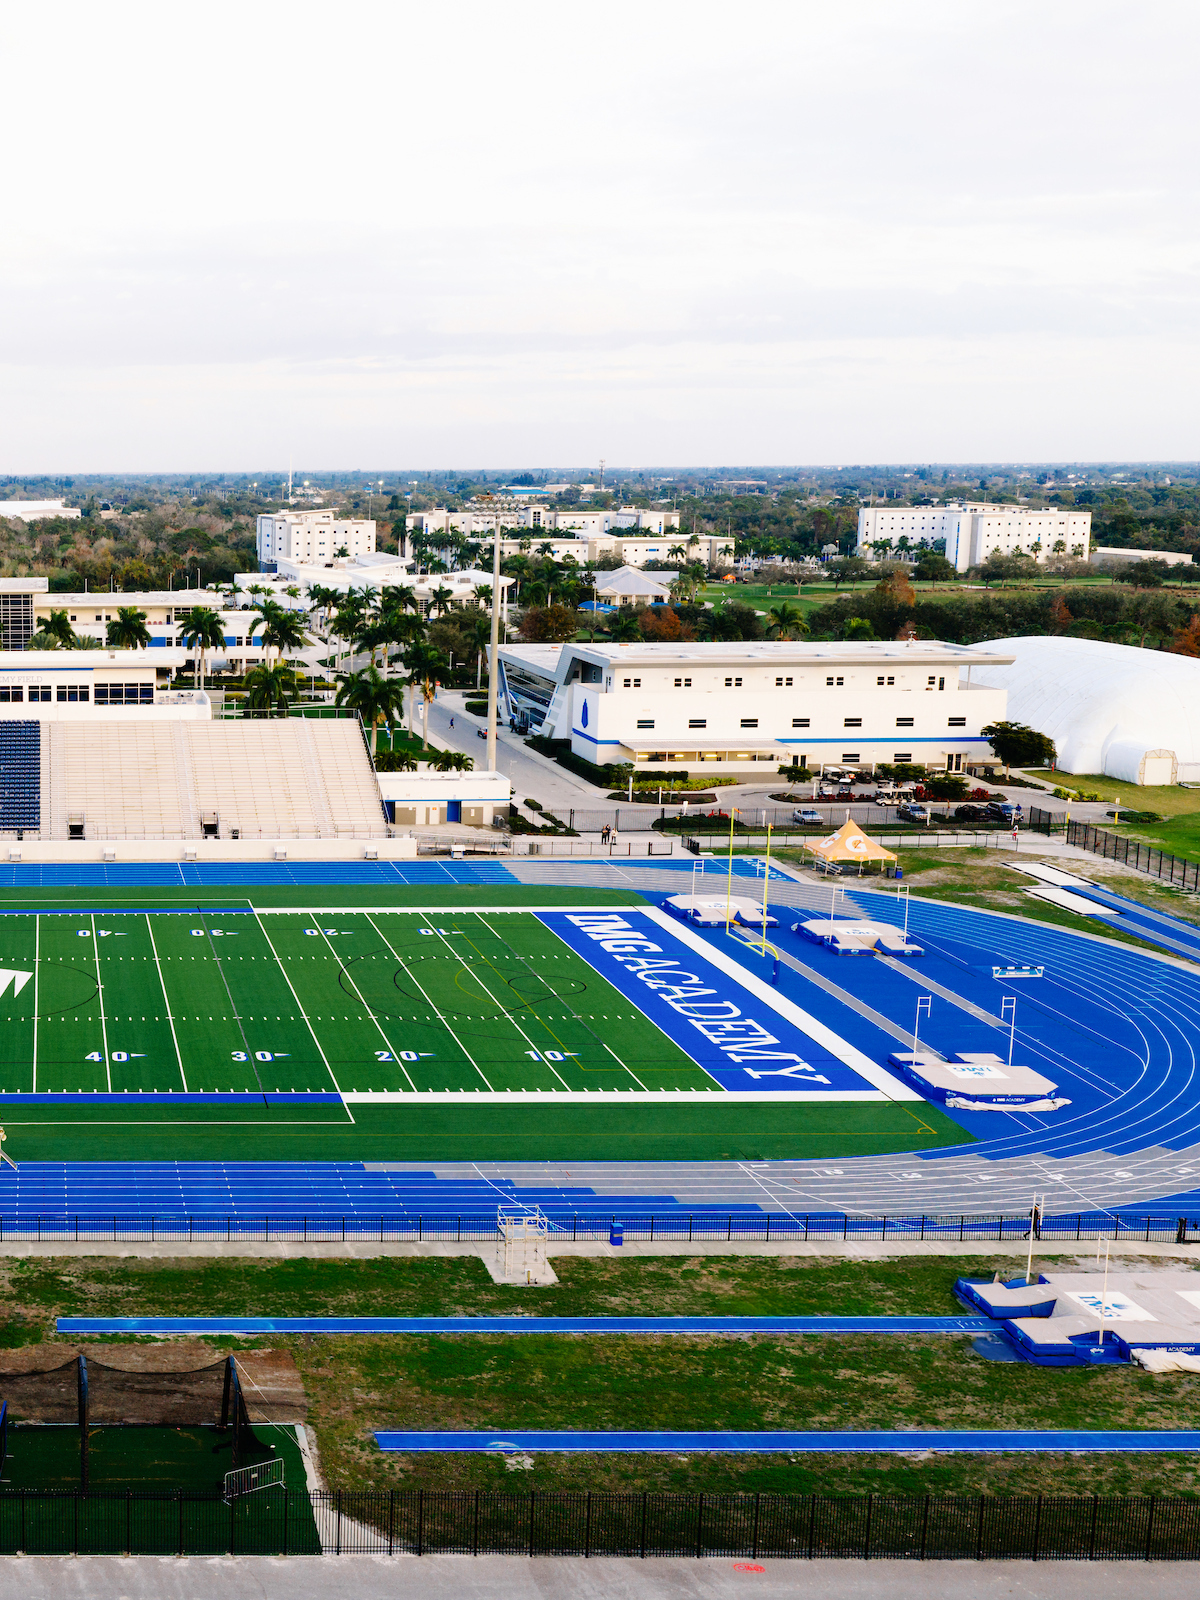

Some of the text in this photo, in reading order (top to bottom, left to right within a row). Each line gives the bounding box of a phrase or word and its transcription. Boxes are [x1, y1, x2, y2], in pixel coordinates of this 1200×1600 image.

[845, 836, 867, 852] G
[564, 914, 832, 1085] IMG ACADEMY
[85, 1051, 130, 1063] 40
[231, 1051, 275, 1062] 30
[374, 1050, 420, 1062] 20
[525, 1050, 567, 1062] 10
